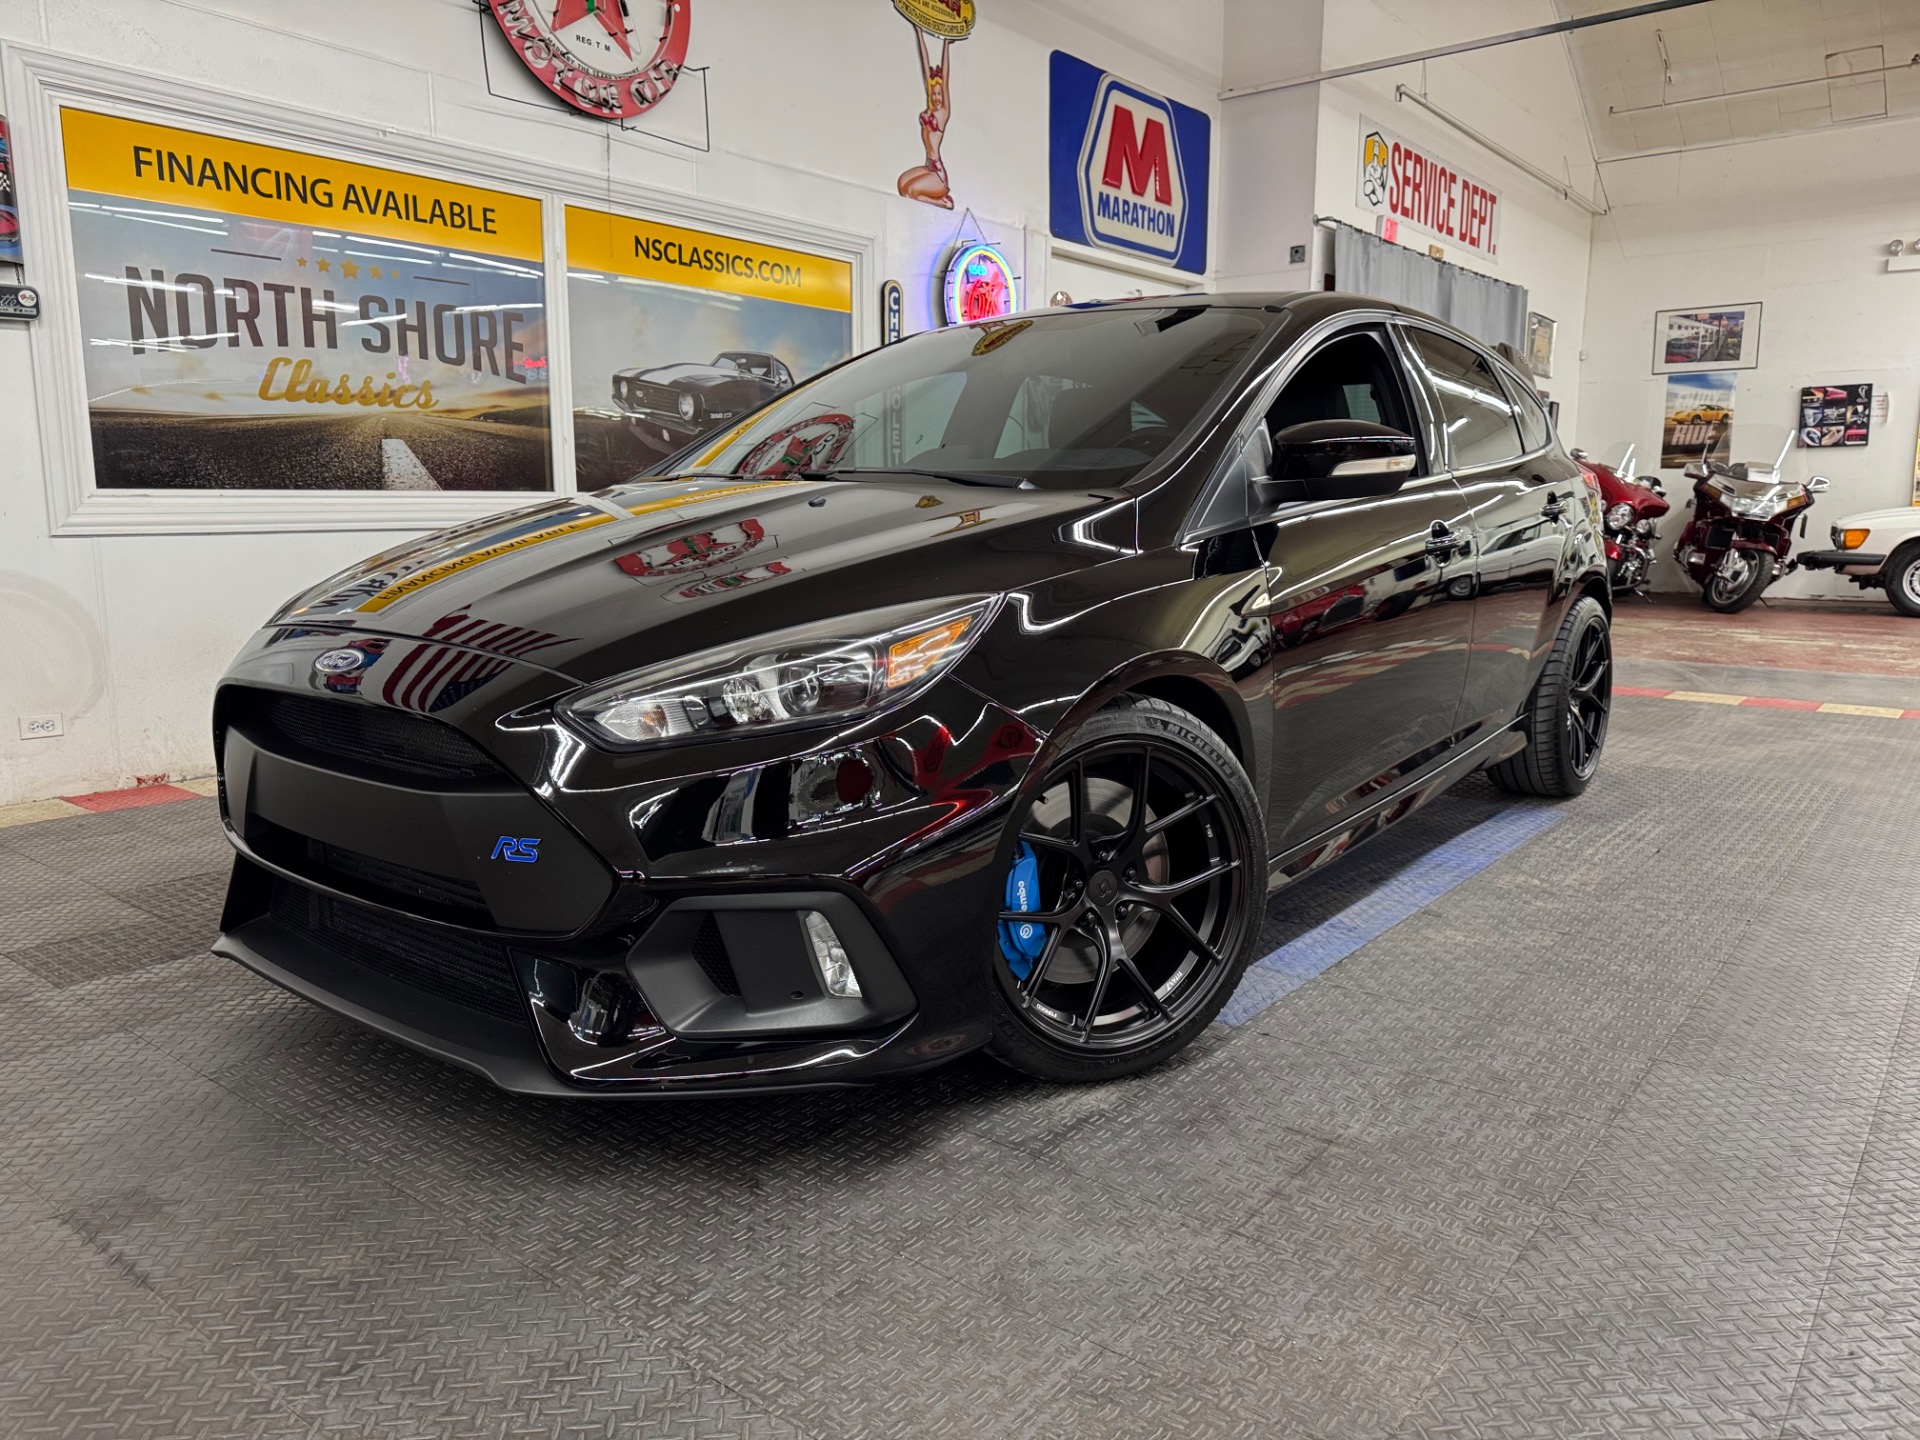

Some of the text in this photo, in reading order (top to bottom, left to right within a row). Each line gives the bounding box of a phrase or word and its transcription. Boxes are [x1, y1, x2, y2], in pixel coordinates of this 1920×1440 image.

[1101, 104, 1173, 206] M
[132, 145, 498, 235] FINANCING AVAILABLE
[1096, 190, 1176, 238] MARATHON
[1389, 141, 1498, 256] SERVICE DEPT.
[634, 235, 802, 288] NSCLASSICS.COM
[124, 265, 527, 385] NORTH SHORE
[258, 356, 440, 410] Classics
[1166, 723, 1233, 776] MICHELIN
[490, 835, 541, 863] RS
